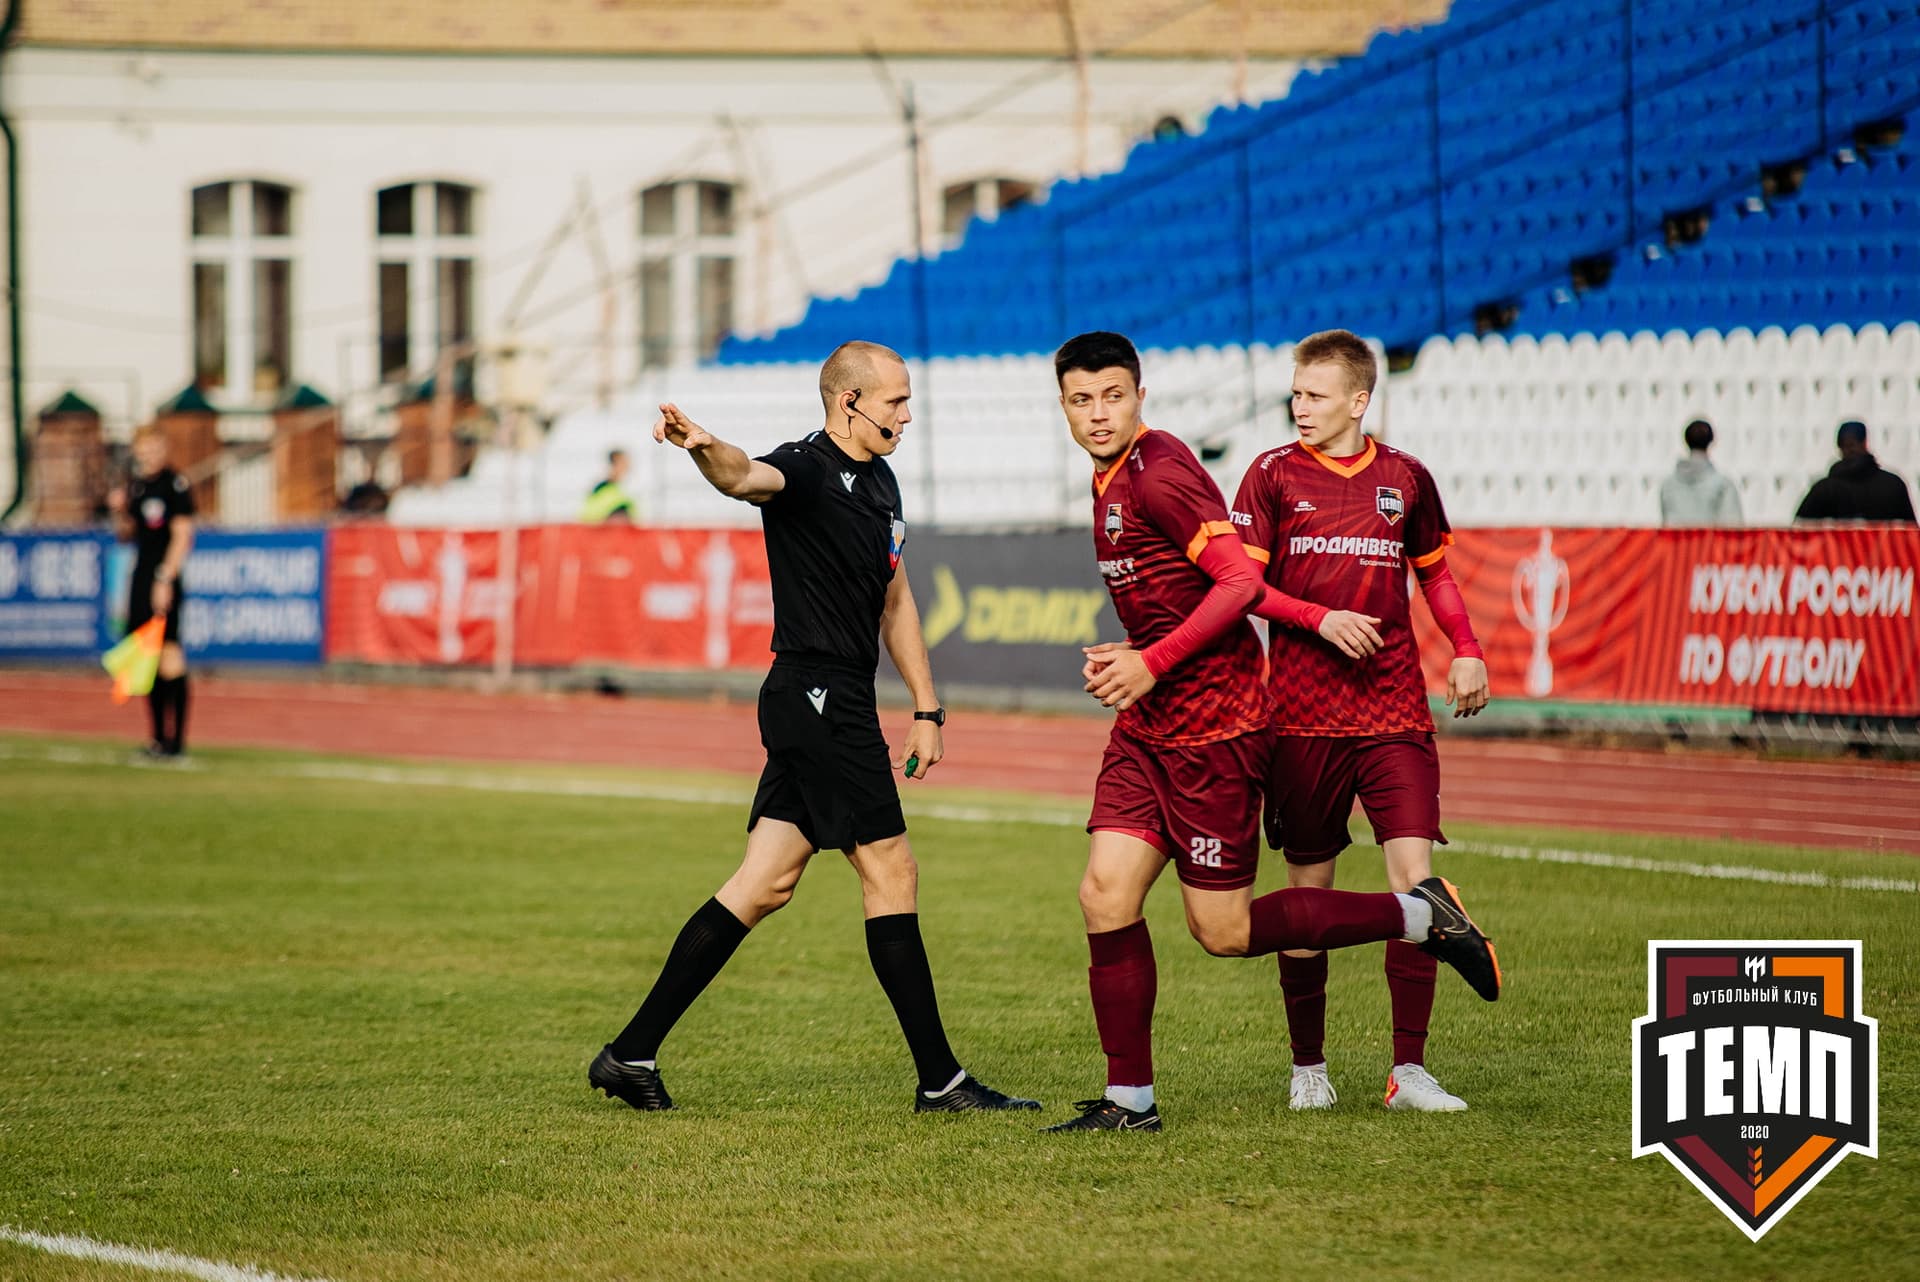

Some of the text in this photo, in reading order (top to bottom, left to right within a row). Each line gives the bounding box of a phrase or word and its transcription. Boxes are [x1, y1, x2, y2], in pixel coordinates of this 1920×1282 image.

[1290, 536, 1404, 558] ПРОДИНВЕСТ
[966, 587, 1104, 643] DEMIX
[1689, 564, 1914, 617] КУБОК РОССИИ
[1680, 633, 1865, 688] ПО ФУТБОЛУ
[1190, 836, 1222, 868] 22
